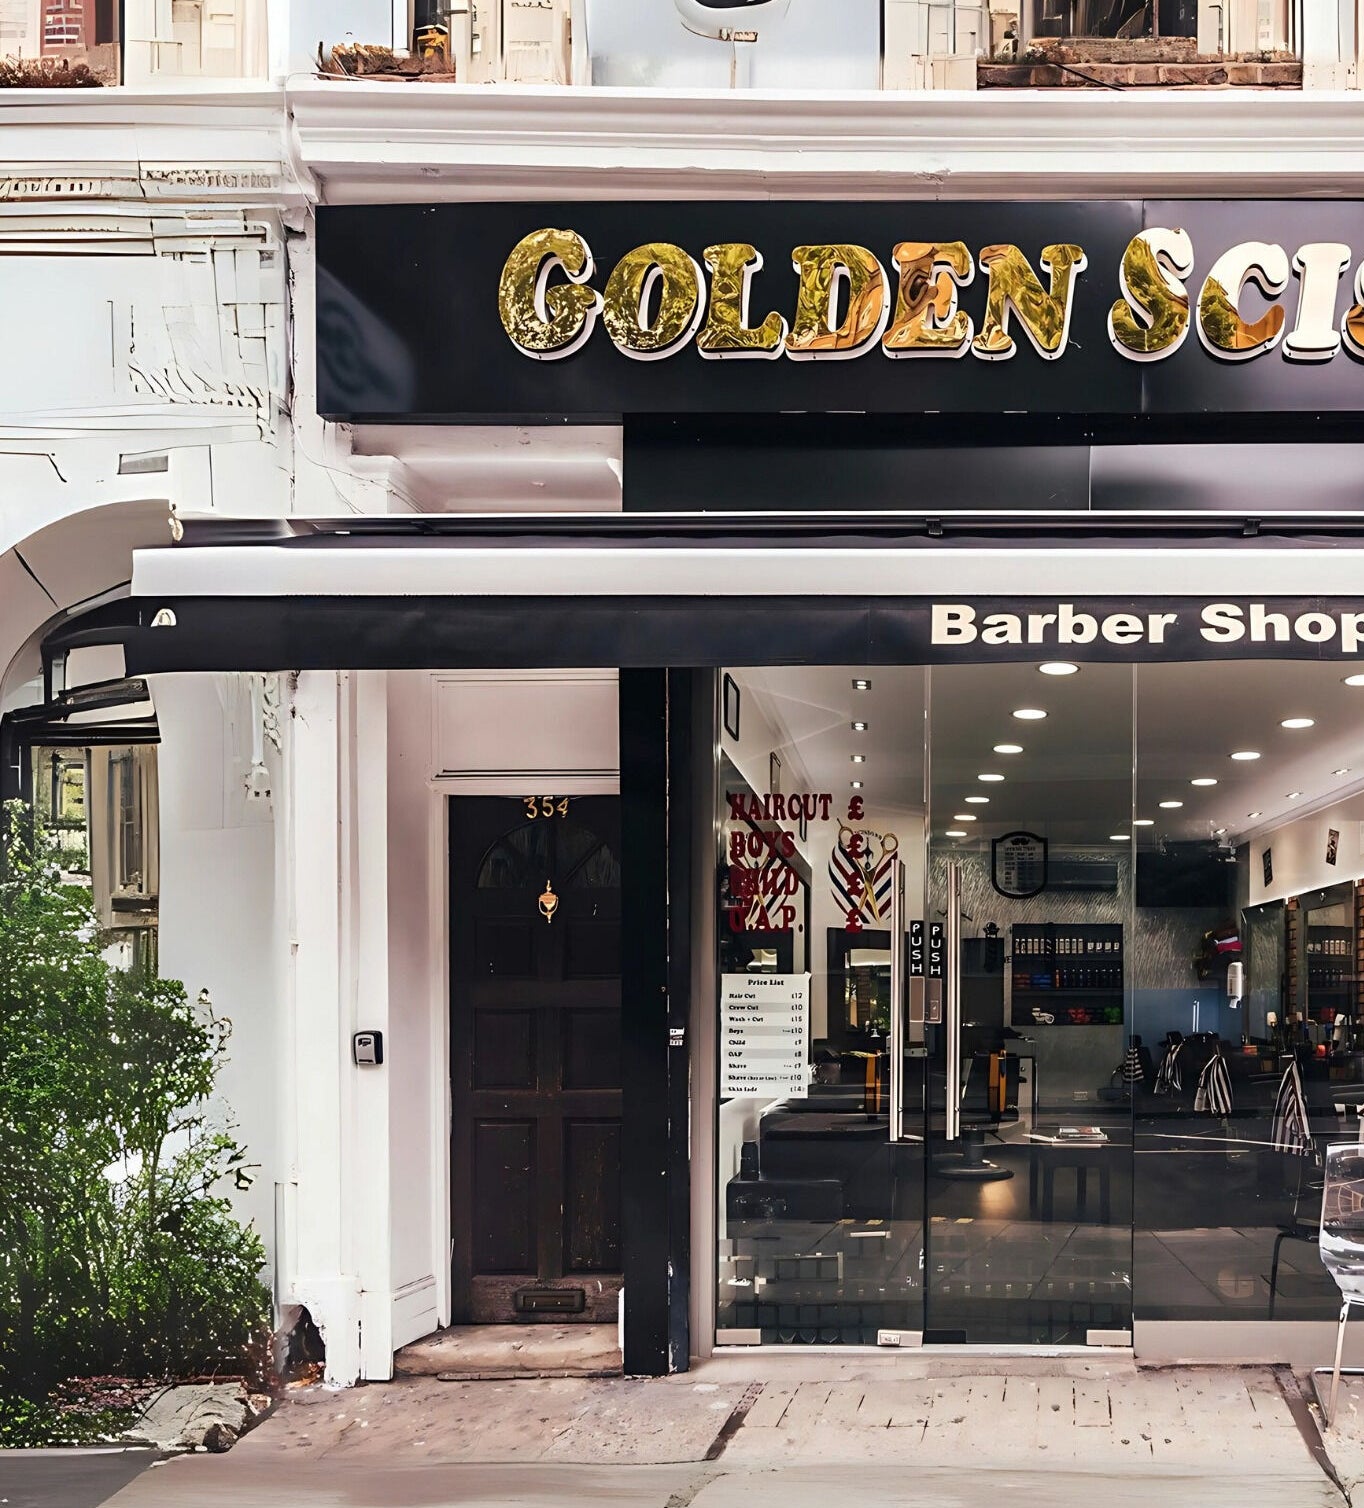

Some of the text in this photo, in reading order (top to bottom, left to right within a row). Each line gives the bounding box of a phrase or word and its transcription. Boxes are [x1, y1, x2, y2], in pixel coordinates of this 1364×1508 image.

[500, 227, 1088, 361] GOLDEN
[931, 603, 1178, 645] Barber
[523, 796, 569, 818] 354
[730, 793, 864, 821] HAIRCUT £
[730, 831, 796, 858] BOYS
[847, 833, 864, 859] £
[911, 923, 923, 974] PUSH
[930, 925, 942, 975] PUSH
